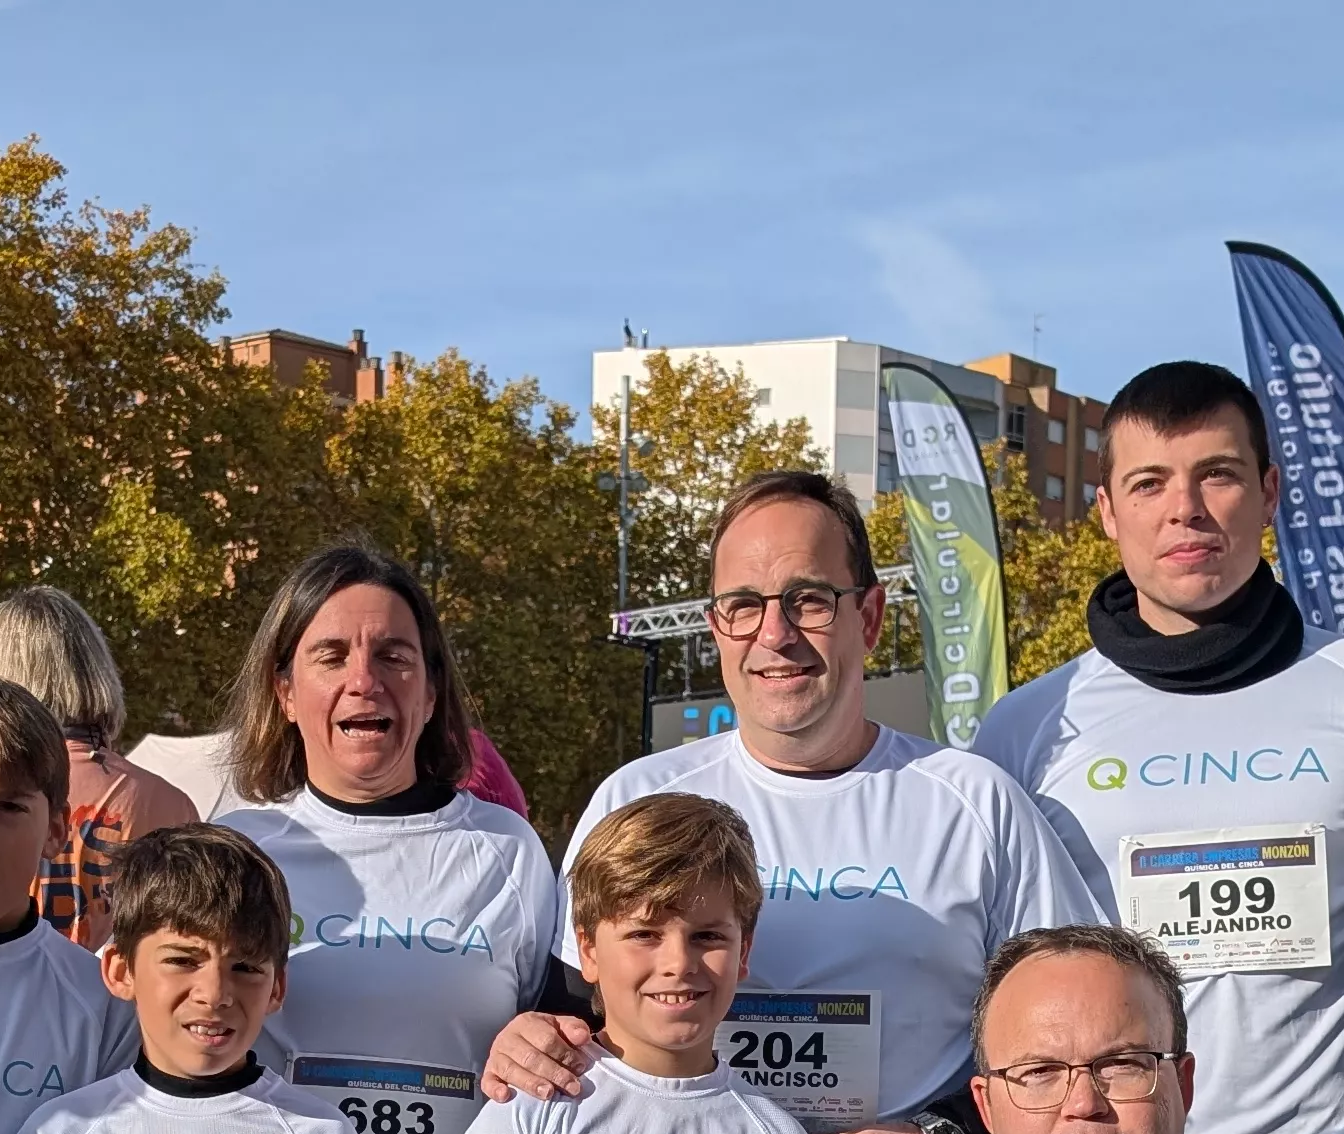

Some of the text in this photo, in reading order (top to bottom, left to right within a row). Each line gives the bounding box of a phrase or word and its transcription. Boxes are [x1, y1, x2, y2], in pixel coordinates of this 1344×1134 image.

[1261, 841, 1309, 859] MONZÓN
[1221, 862, 1236, 870] DEL
[1178, 876, 1275, 918] 199
[1158, 914, 1292, 937] ALEJANDRO
[817, 999, 864, 1016] MONZÓN
[728, 1030, 828, 1070] 204
[425, 1073, 469, 1091] MONZÓN
[741, 1071, 838, 1088] ANCISCO
